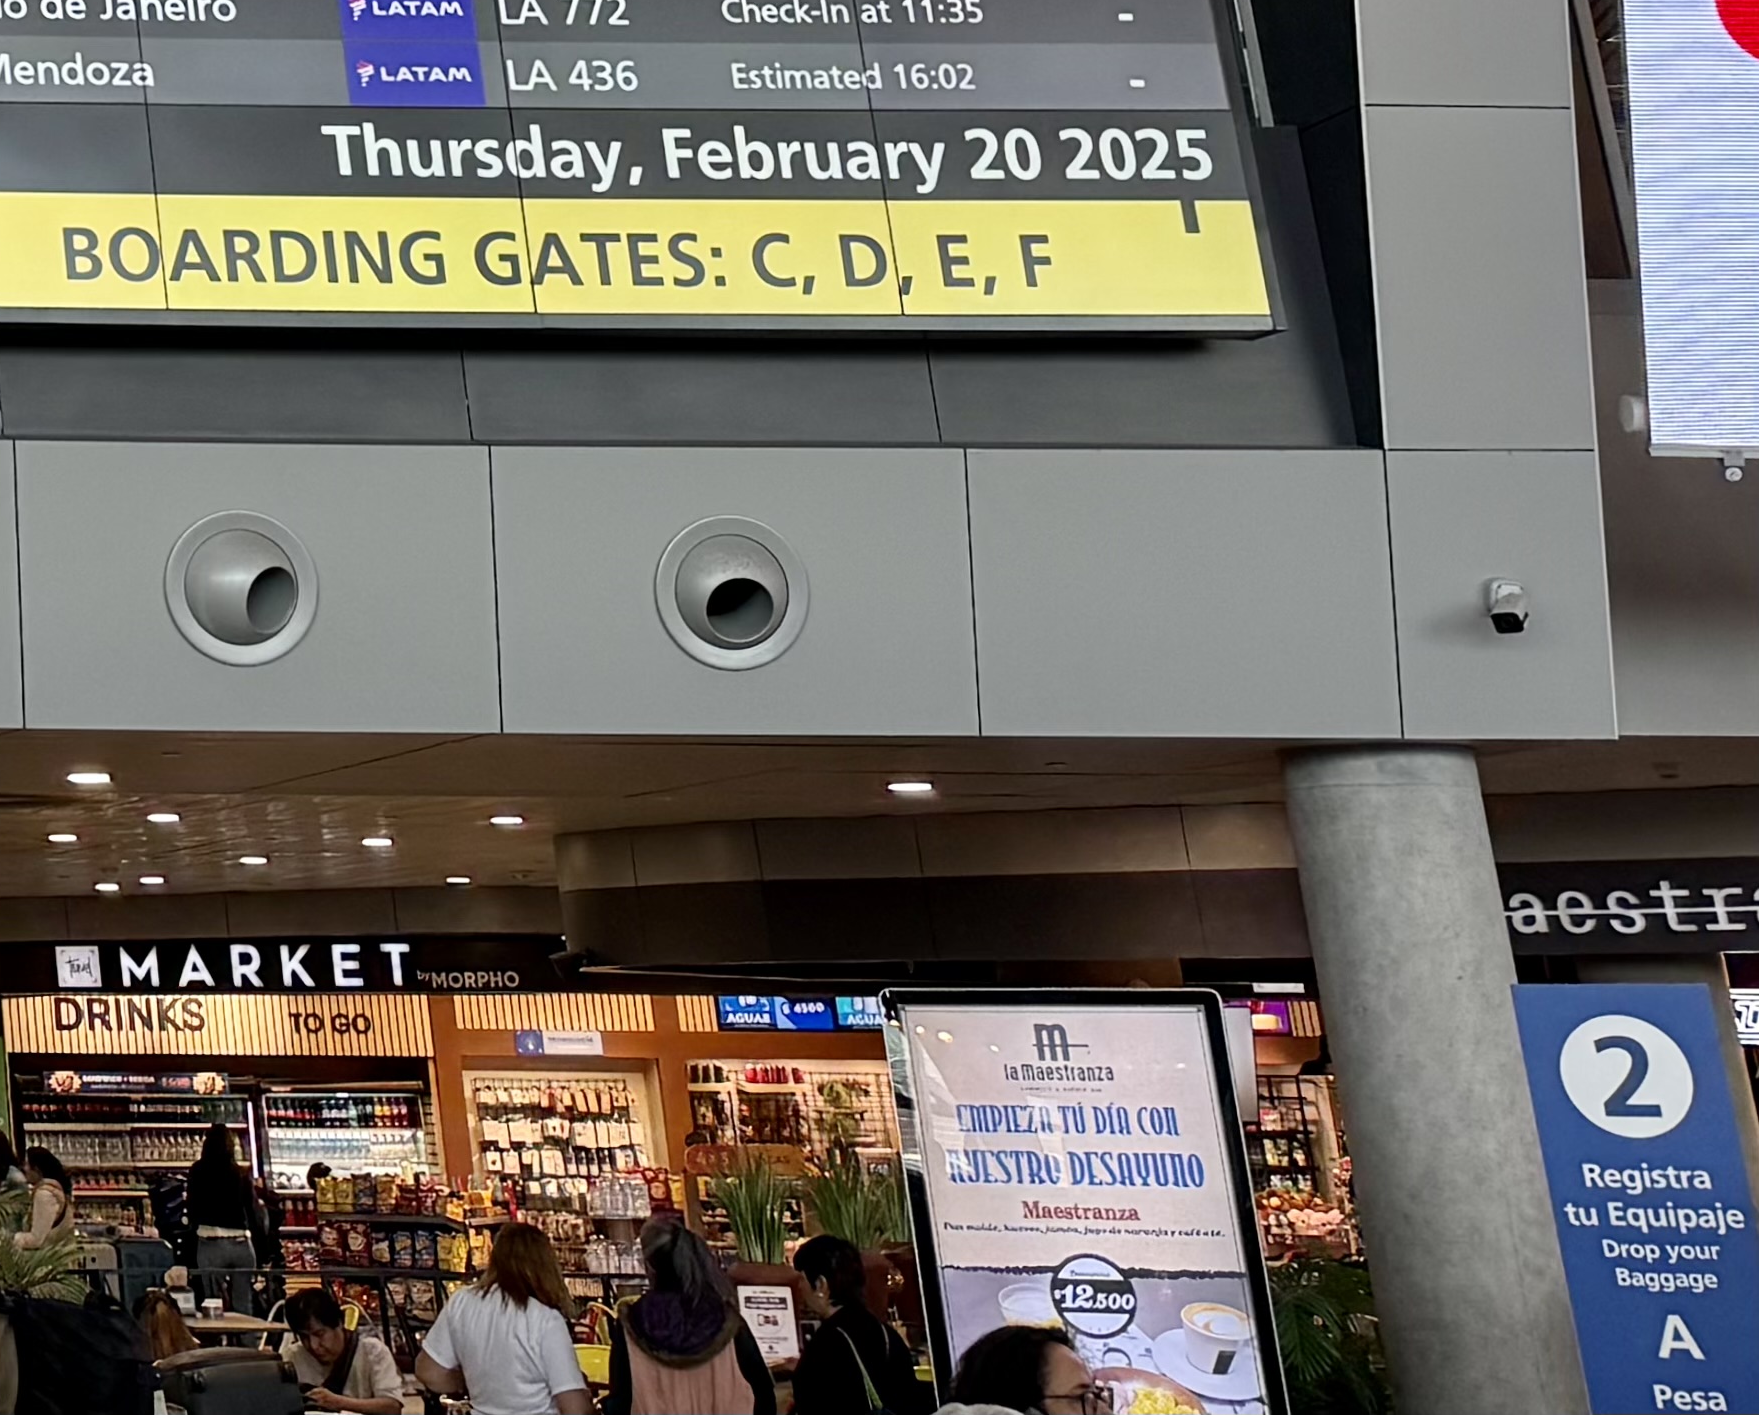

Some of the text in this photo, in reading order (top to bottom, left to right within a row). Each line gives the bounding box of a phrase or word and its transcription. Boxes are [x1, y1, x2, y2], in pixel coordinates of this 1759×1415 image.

[321, 122, 1212, 193] Thursday, February 20 2025
[63, 221, 1051, 303] BOARDING GATES: C, D, E, F
[120, 944, 409, 987] MARKET
[432, 971, 519, 988] MORPHO
[54, 996, 371, 1035] DRINKS TO GO
[1005, 1062, 1113, 1082] la Maestranza
[1594, 1036, 1662, 1117] 2
[957, 1102, 1180, 1136] EMPIEZA TÚ DÍA CON
[947, 1148, 1204, 1188] NUESTRO DESAYUNO
[1582, 1163, 1711, 1194] Registra
[1022, 1201, 1141, 1222] Maestranza
[1564, 1202, 1744, 1234] tu Equipaje
[1602, 1239, 1720, 1263] Drop your
[1615, 1268, 1717, 1292] Baggage
[1659, 1315, 1705, 1359] A
[1653, 1385, 1727, 1411] Pesa
